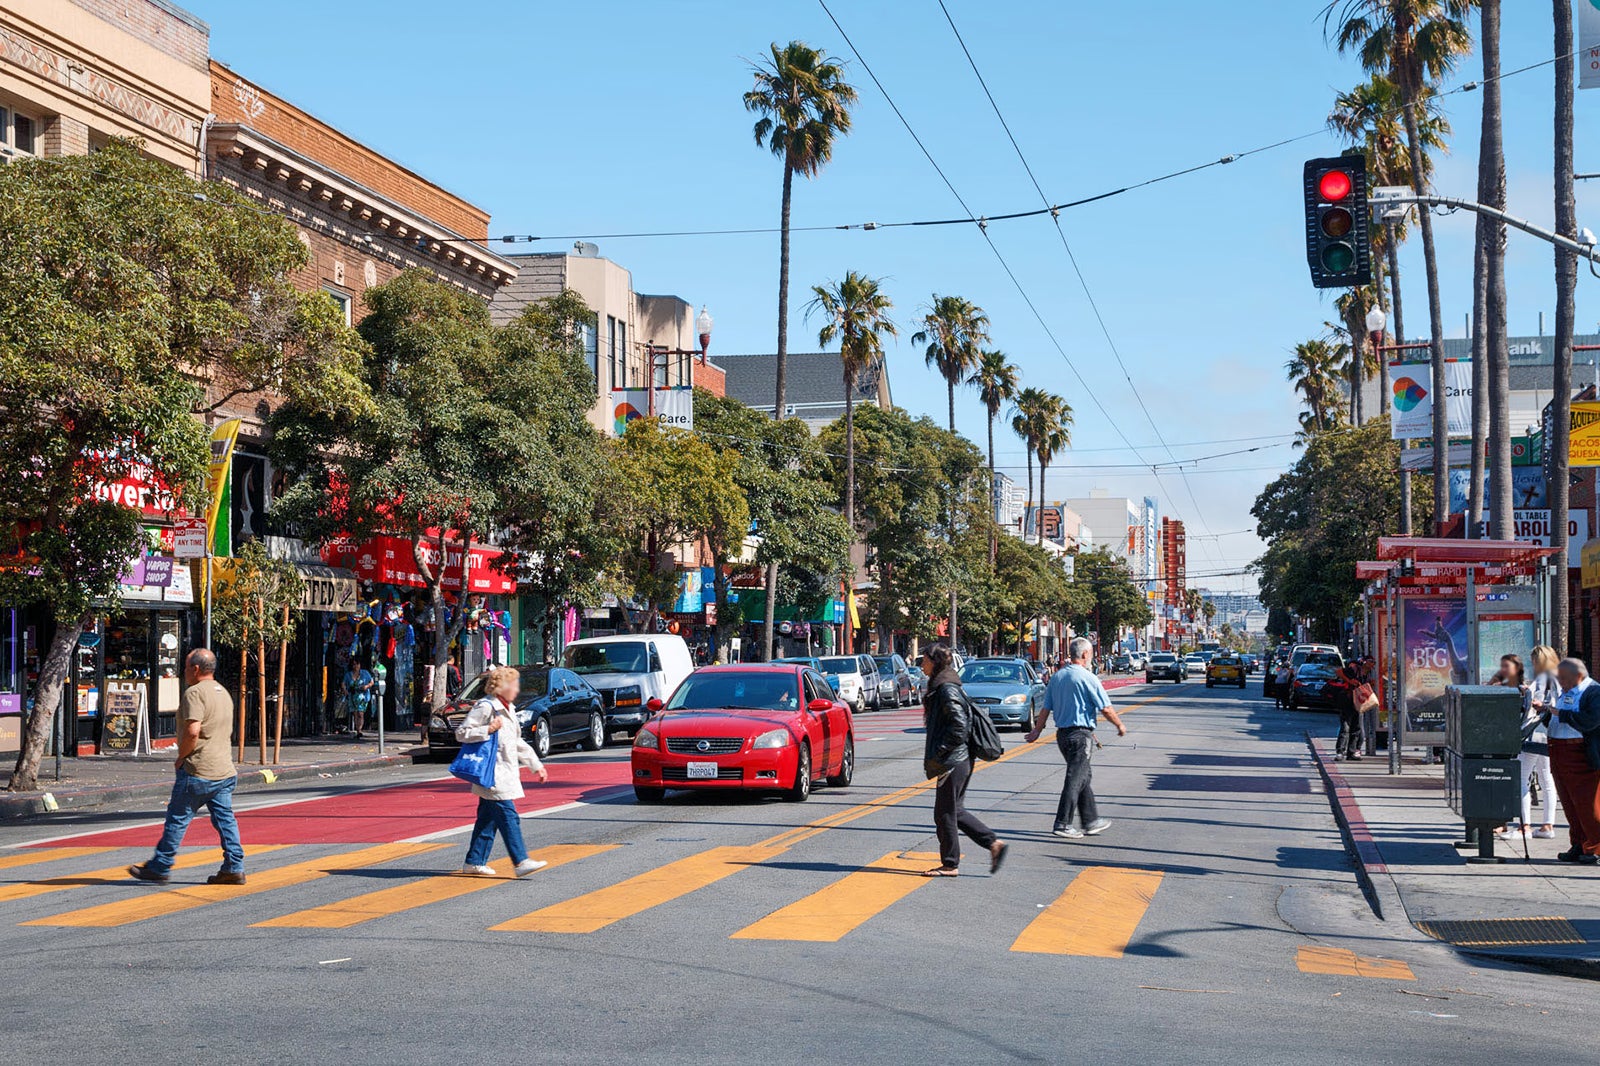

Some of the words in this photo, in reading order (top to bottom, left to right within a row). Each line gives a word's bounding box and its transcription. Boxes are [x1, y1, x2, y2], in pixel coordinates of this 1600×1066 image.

[1509, 341, 1542, 355] ank
[659, 413, 690, 424] Care.
[1526, 511, 1548, 520] TABLE
[337, 545, 359, 553] CITY
[420, 547, 463, 567] DISCUNT
[469, 553, 483, 569] ITY
[146, 560, 171, 571] VAPOR
[1438, 568, 1462, 577] RAPID
[1502, 567, 1526, 576] RAPID
[145, 572, 167, 583] SHOP
[1402, 586, 1421, 594] RAPID
[1453, 586, 1466, 594] RAP
[1413, 647, 1448, 669] BFG
